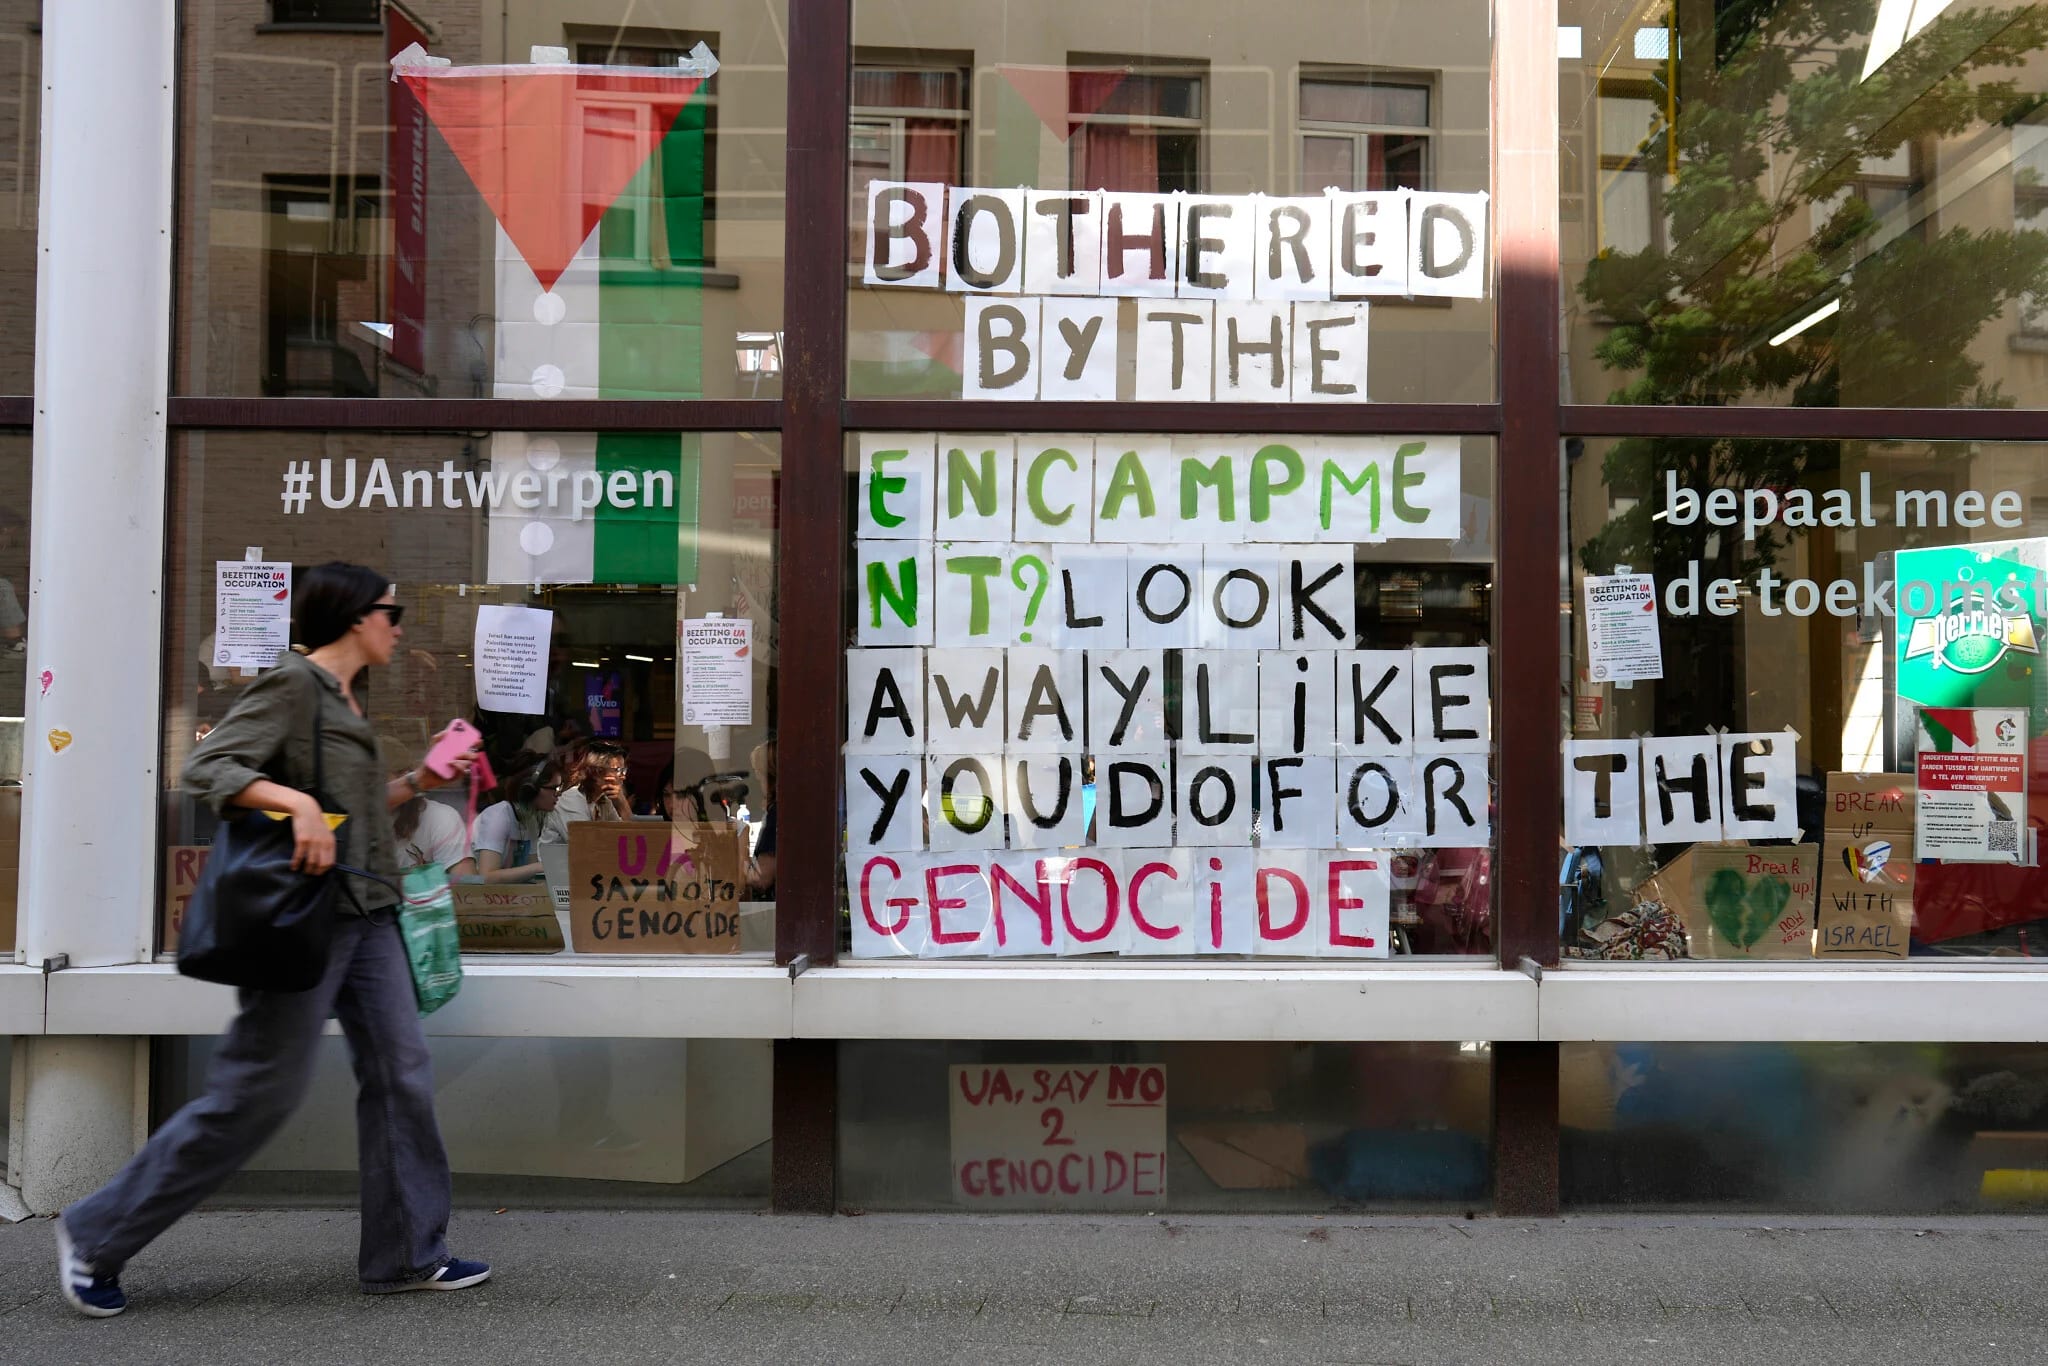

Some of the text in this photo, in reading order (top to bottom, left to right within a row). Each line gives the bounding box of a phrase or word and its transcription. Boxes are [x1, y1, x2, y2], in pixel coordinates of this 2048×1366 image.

[873, 187, 1477, 289] BOTHERED
[977, 303, 1358, 395] BY THE
[281, 456, 675, 523] #UAntwerpen
[867, 441, 1431, 532] ENCAMPME
[1665, 470, 2024, 541] bepaal mee
[222, 571, 285, 581] BEZETTING UA
[224, 580, 285, 588] OCCUPATION
[1590, 584, 1650, 594] BEZETTING UA
[1665, 560, 1738, 618] de
[1592, 592, 1651, 602] OCCUPATION
[686, 629, 745, 637] BEZETTING UA
[861, 664, 1151, 746] AWAY
[859, 737, 1776, 844] YOU DO FOR THE
[1835, 791, 1903, 812] BREAK
[1852, 822, 1874, 838] UP
[1745, 854, 1800, 874] Break
[590, 873, 650, 902] SAY
[657, 878, 701, 901] NO
[1792, 877, 1814, 900] up!
[1832, 891, 1894, 912] WITH
[1824, 925, 1899, 948] ISRAEL
[960, 1065, 1165, 1106] UA, SAY NO
[1040, 1106, 1076, 1146] 2
[960, 1150, 1165, 1197] GENOCIDE!
